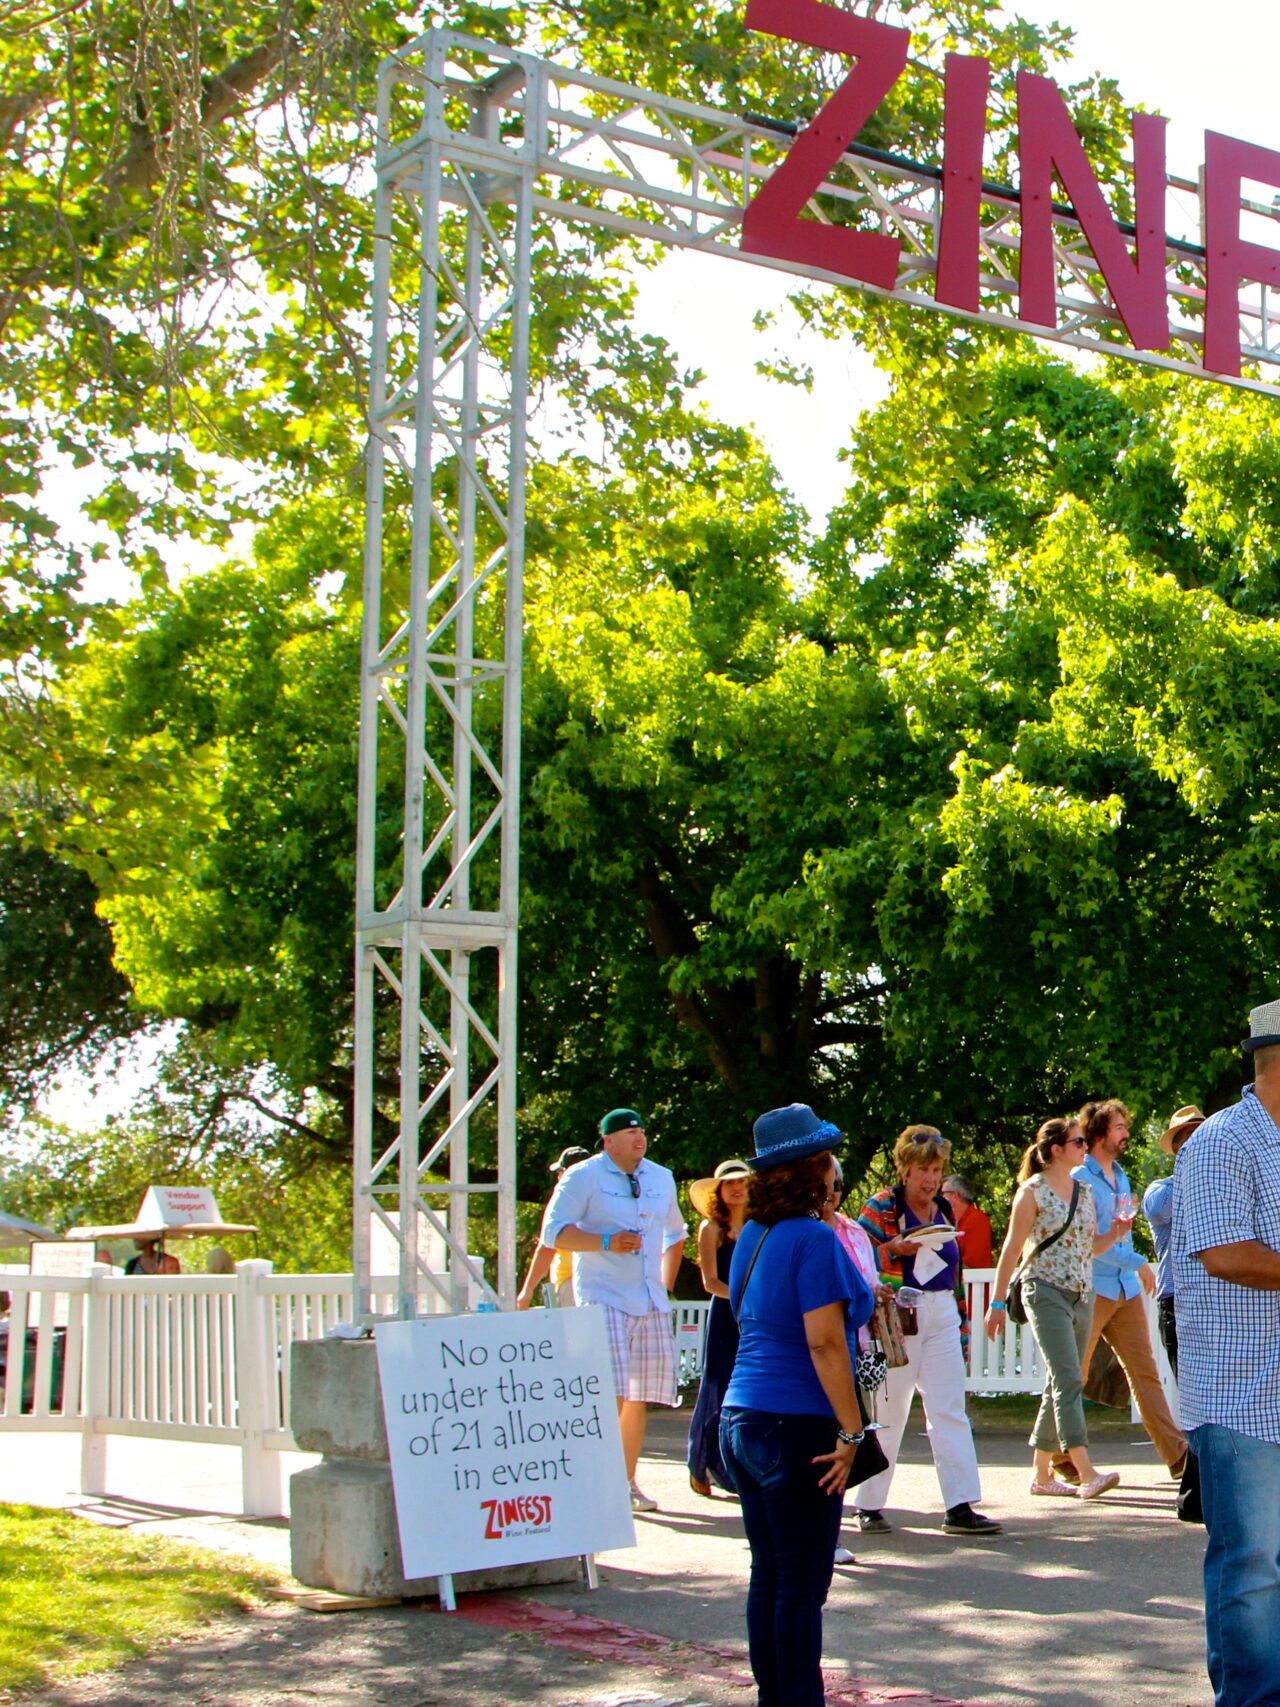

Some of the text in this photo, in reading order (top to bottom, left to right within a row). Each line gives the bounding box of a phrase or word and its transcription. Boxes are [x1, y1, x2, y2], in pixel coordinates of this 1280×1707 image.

[166, 1190, 200, 1199] Vendor
[167, 1201, 207, 1212] Support
[441, 1339, 554, 1369] No one
[401, 1369, 601, 1414] under the age
[409, 1405, 603, 1456] of 21 allowed
[453, 1449, 573, 1491] in event
[480, 1495, 552, 1540] ZINFEST
